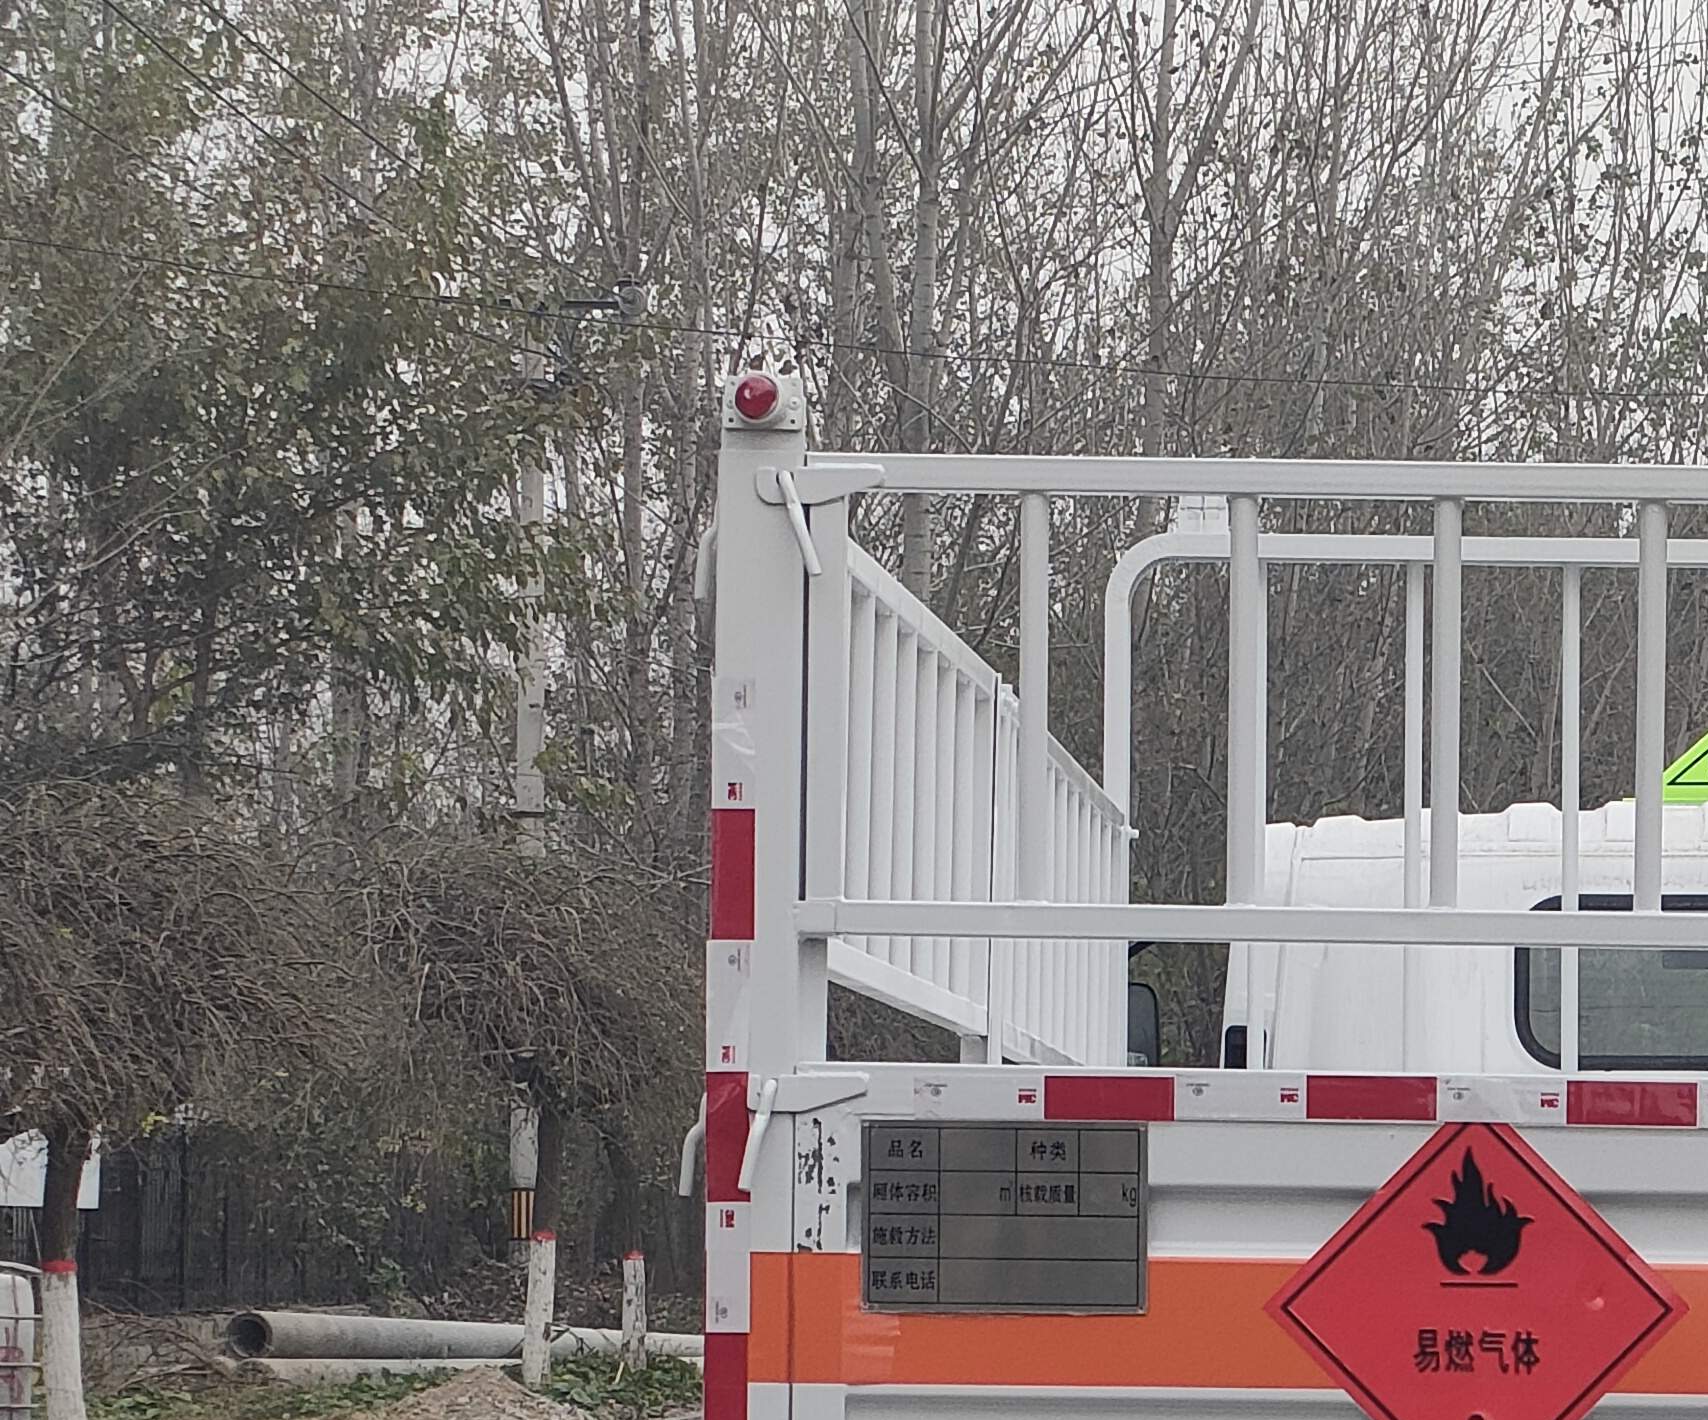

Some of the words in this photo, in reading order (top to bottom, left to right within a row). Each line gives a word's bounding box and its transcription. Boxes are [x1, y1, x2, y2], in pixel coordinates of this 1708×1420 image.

[888, 1140, 923, 1159] 品名
[1030, 1141, 1066, 1161] 种类
[1121, 1184, 1137, 1207] kg
[872, 1270, 936, 1290] 联系电话
[1414, 1329, 1540, 1374] 易燃气体
